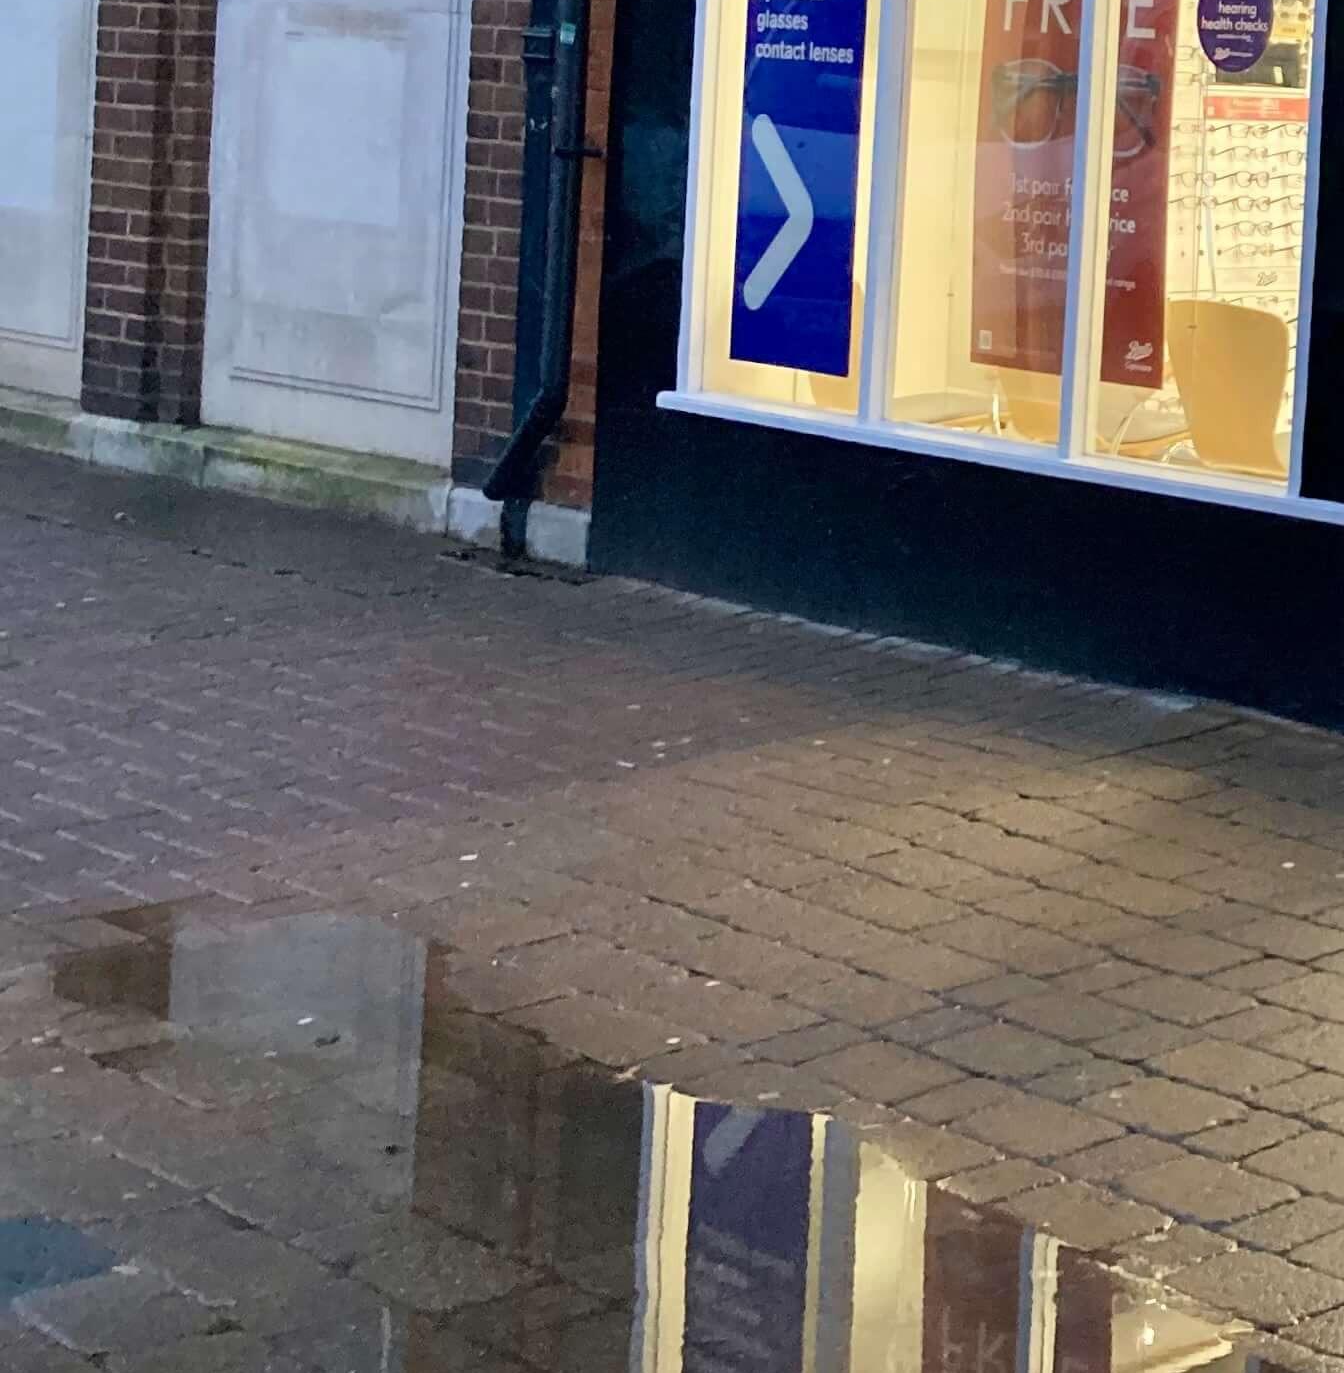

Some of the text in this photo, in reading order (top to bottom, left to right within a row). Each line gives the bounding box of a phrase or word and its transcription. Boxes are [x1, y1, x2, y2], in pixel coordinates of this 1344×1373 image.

[757, 10, 808, 32] glasses
[1218, 1, 1257, 19] hearing
[1201, 17, 1269, 32] health checks
[755, 41, 853, 63] contact lenses
[1002, 202, 1030, 223] 2nd
[1110, 212, 1136, 233] rice
[1021, 232, 1068, 260] 3rd pa
